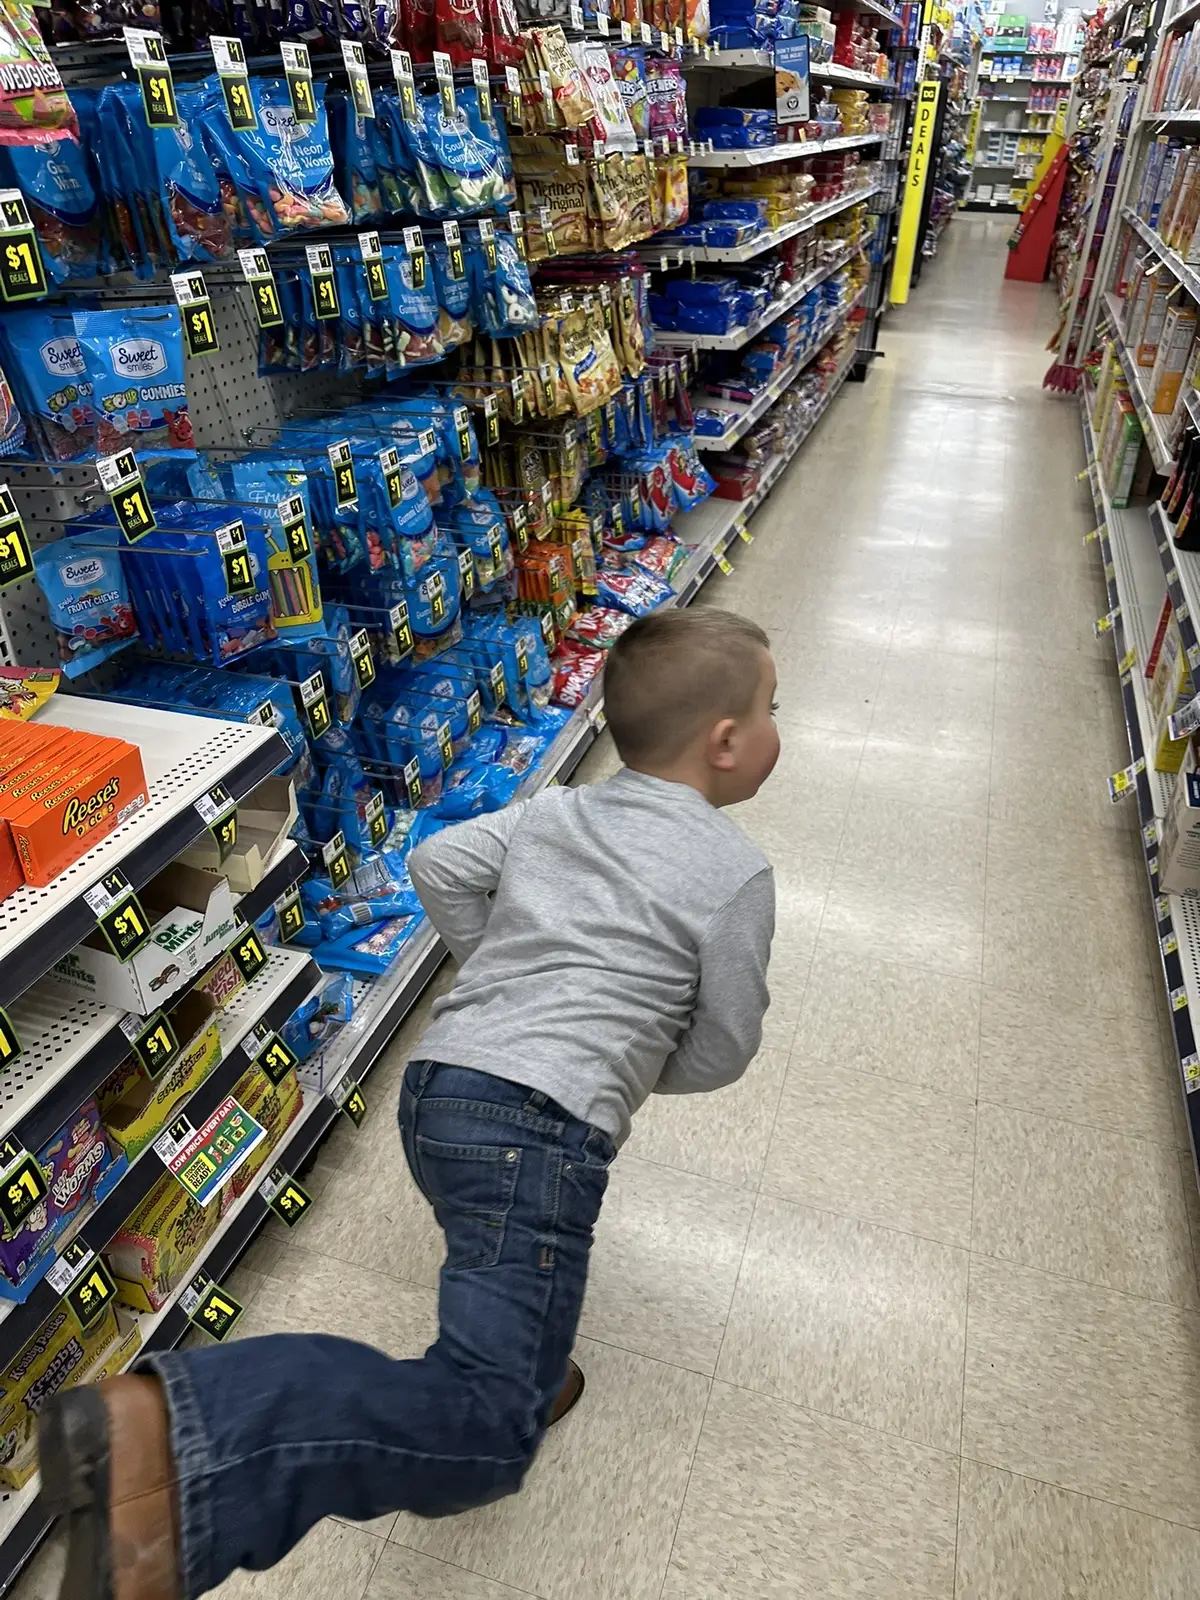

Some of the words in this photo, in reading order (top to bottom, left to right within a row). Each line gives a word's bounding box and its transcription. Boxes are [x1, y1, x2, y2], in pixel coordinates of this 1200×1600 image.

[148, 39, 160, 60] $1
[229, 42, 241, 62] $1
[150, 78, 173, 116] $1
[231, 86, 252, 119] $1
[295, 82, 312, 112] $1
[356, 79, 370, 108] $1
[404, 87, 416, 120] $1
[444, 86, 455, 112] $1
[923, 90, 935, 99] DG
[152, 103, 166, 113] DEALS
[234, 108, 246, 117] DEALS
[293, 144, 323, 157] Neon
[911, 108, 930, 187] DEALS
[544, 191, 585, 213] Original
[6, 203, 23, 223] $1
[6, 243, 37, 283] $1
[257, 257, 267, 272] $1
[320, 253, 330, 267] $1
[415, 257, 424, 280] $1
[454, 250, 463, 272] $1
[9, 272, 28, 284] DEALS
[372, 265, 384, 287] $1
[192, 283, 202, 296] $1
[320, 281, 334, 307] $1
[259, 286, 277, 315] $1
[192, 312, 213, 342] $1
[194, 334, 206, 343] DEALS
[47, 343, 83, 364] Sweet
[118, 346, 158, 364] Sweet
[140, 384, 185, 401] GUMMIES
[491, 418, 497, 436] $1
[340, 447, 349, 461] $1
[461, 431, 471, 459] $1
[118, 459, 131, 473] $1
[341, 470, 353, 493] $1
[391, 477, 400, 496] $1
[123, 492, 148, 523] $1
[291, 502, 299, 514] $1
[128, 515, 141, 528] DEALS
[231, 528, 241, 543] $1
[292, 528, 307, 551] $1
[0, 532, 26, 567] $1
[1, 559, 18, 571] DEALS
[66, 560, 99, 579] Sweet
[232, 556, 249, 583] $1
[466, 571, 473, 589] $1
[68, 600, 93, 615] FRUITY
[94, 590, 121, 607] CHEWS
[231, 598, 254, 614] BUBBLE
[255, 589, 271, 602] GUM
[435, 598, 442, 614] $1
[400, 627, 410, 644] $1
[360, 656, 372, 674] $1
[312, 677, 322, 692] $1
[261, 707, 272, 720] $1
[314, 703, 327, 723] $1
[444, 743, 452, 759] $1
[0, 772, 28, 792] Reese's
[11, 776, 43, 798] Reese's
[30, 779, 61, 801] Reese's
[412, 779, 421, 795] $1
[44, 786, 74, 809] Reese's
[211, 789, 226, 801] $1
[62, 777, 120, 836] Reese's
[222, 821, 235, 844] $1
[375, 816, 385, 832] $1
[335, 858, 347, 875] $1
[106, 874, 123, 890] $1
[115, 907, 143, 934] $1
[286, 906, 300, 924] $1
[120, 932, 137, 948] DEALS
[163, 920, 203, 953] Mints
[203, 919, 231, 947] Junior
[240, 938, 262, 960] $1
[215, 969, 241, 1004] Fish
[147, 1027, 171, 1052] $1
[256, 1024, 267, 1036] $1
[152, 1054, 165, 1067] DEALS
[267, 1045, 290, 1066] $1
[157, 1075, 183, 1104] SOUR
[180, 1044, 207, 1079] PATCH
[350, 1093, 364, 1111] $1
[171, 1122, 185, 1136] $1
[171, 1155, 187, 1171] LOW
[187, 1136, 203, 1155] PRICE
[203, 1117, 221, 1137] EVERY
[220, 1101, 235, 1117] DAY!
[54, 1142, 106, 1208] WORMS
[185, 1157, 202, 1178] STOCKING
[189, 1163, 206, 1181] STUFFER
[272, 1169, 283, 1181] $1
[8, 1171, 39, 1202] $1
[13, 1197, 31, 1217] DEALS
[281, 1188, 305, 1207] $1
[67, 1243, 84, 1258] $1
[80, 1273, 108, 1302] $1
[194, 1276, 206, 1288] $1
[84, 1297, 100, 1314] DEALS
[204, 1297, 234, 1320] $1
[214, 1314, 227, 1330] DEALS
[8, 1338, 44, 1382] Krabby
[41, 1312, 67, 1347] Patties
[72, 1353, 97, 1382] GUMMY
[95, 1331, 116, 1356] CANDY
[21, 1336, 81, 1408] Krabby
